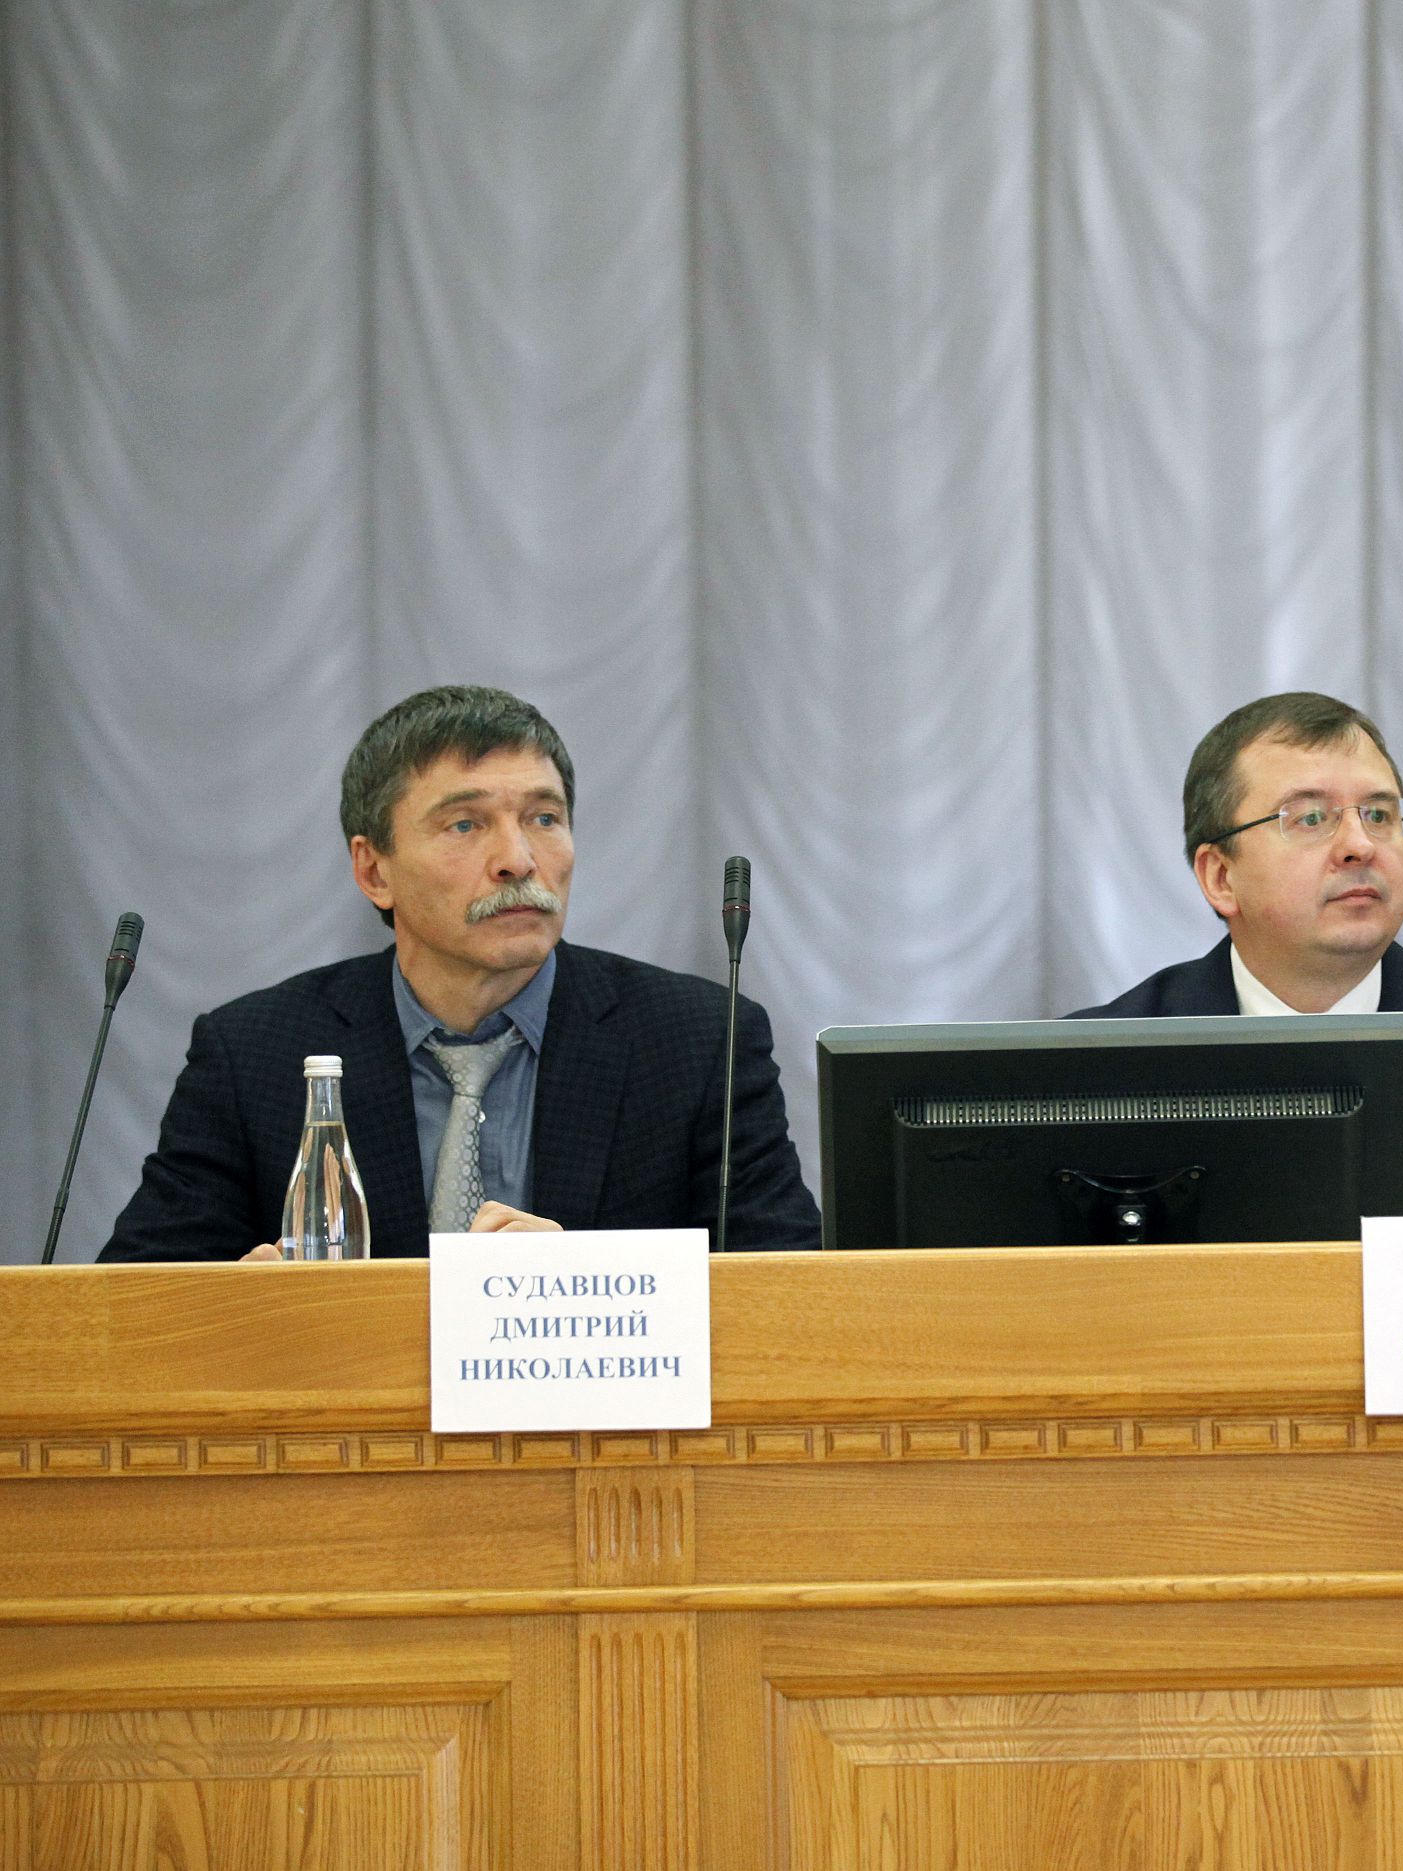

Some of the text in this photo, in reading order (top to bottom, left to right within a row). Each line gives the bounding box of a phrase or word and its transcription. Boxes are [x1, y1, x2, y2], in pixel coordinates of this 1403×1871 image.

[482, 1274, 657, 1301] СУДАВЦОВ
[489, 1310, 649, 1343] ДМИТРИЙ
[459, 1355, 681, 1381] НИКОЛАЕВИЧ
